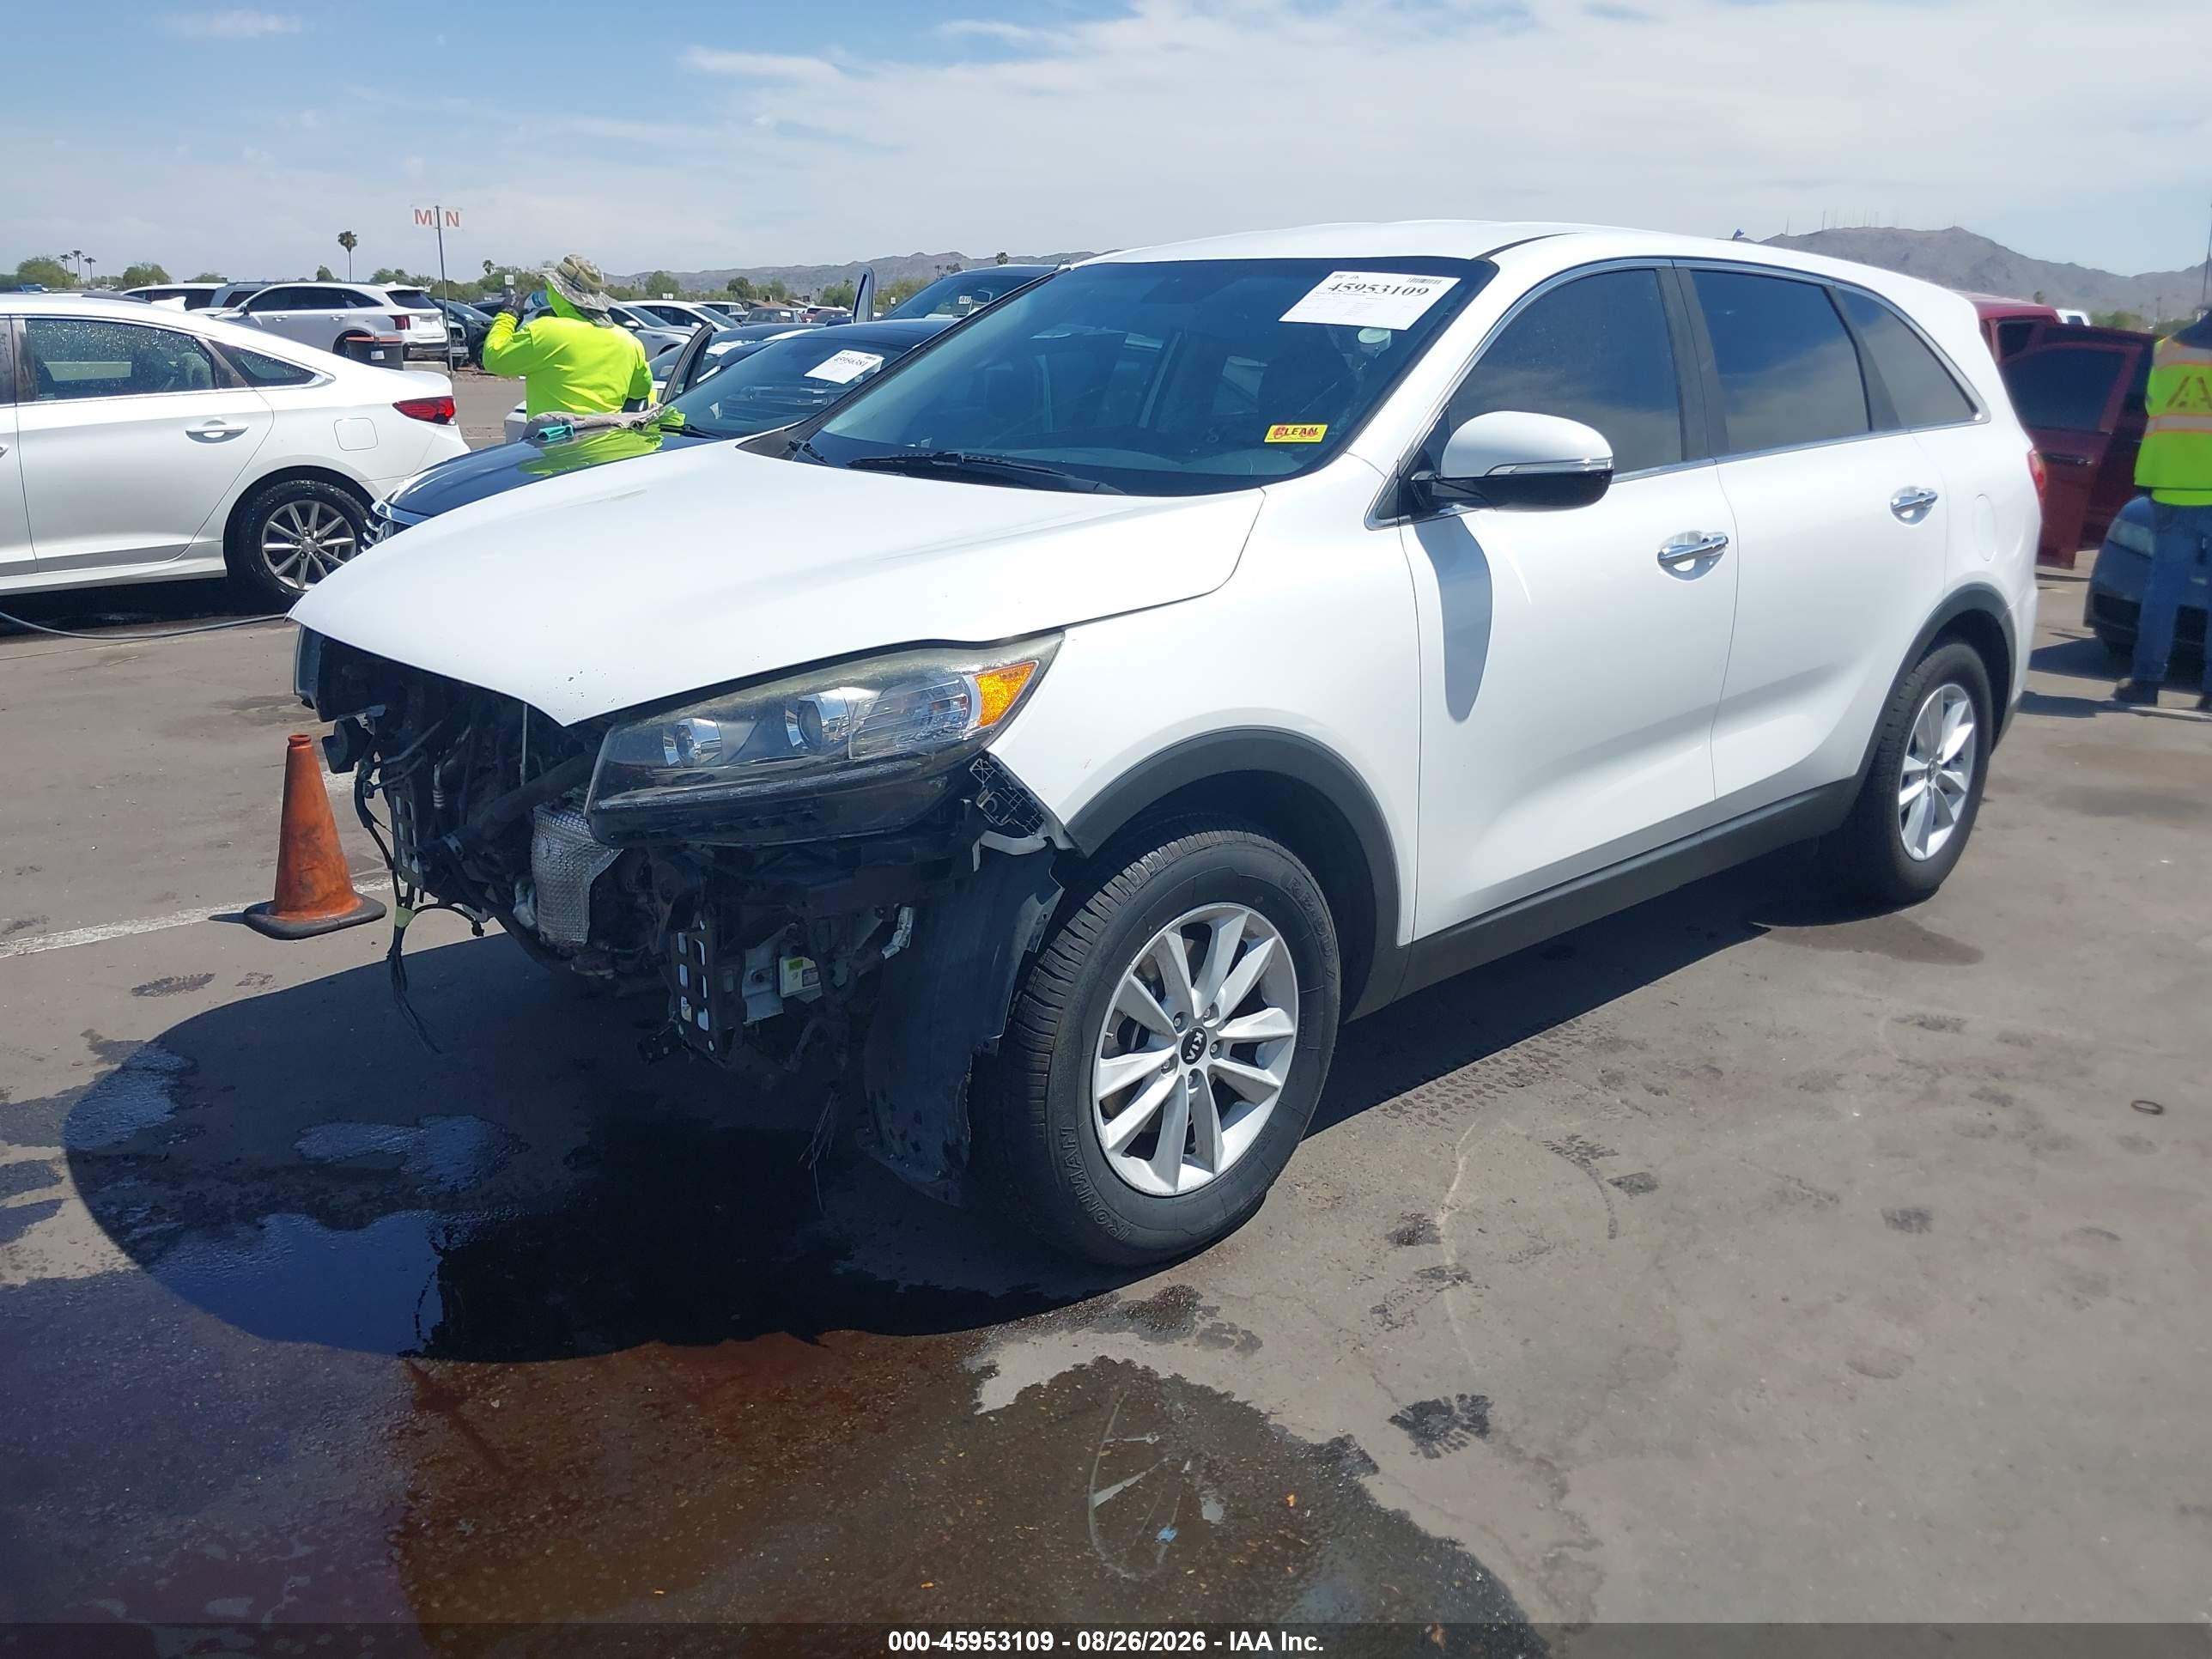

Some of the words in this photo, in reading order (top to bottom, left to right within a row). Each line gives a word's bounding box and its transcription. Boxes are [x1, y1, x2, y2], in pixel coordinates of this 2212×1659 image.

[414, 209, 432, 226] M
[446, 211, 459, 228] N
[1328, 283, 1430, 296] 45953109
[1185, 1031, 1204, 1060] KIA
[1060, 1126, 1133, 1242] IRONMAN
